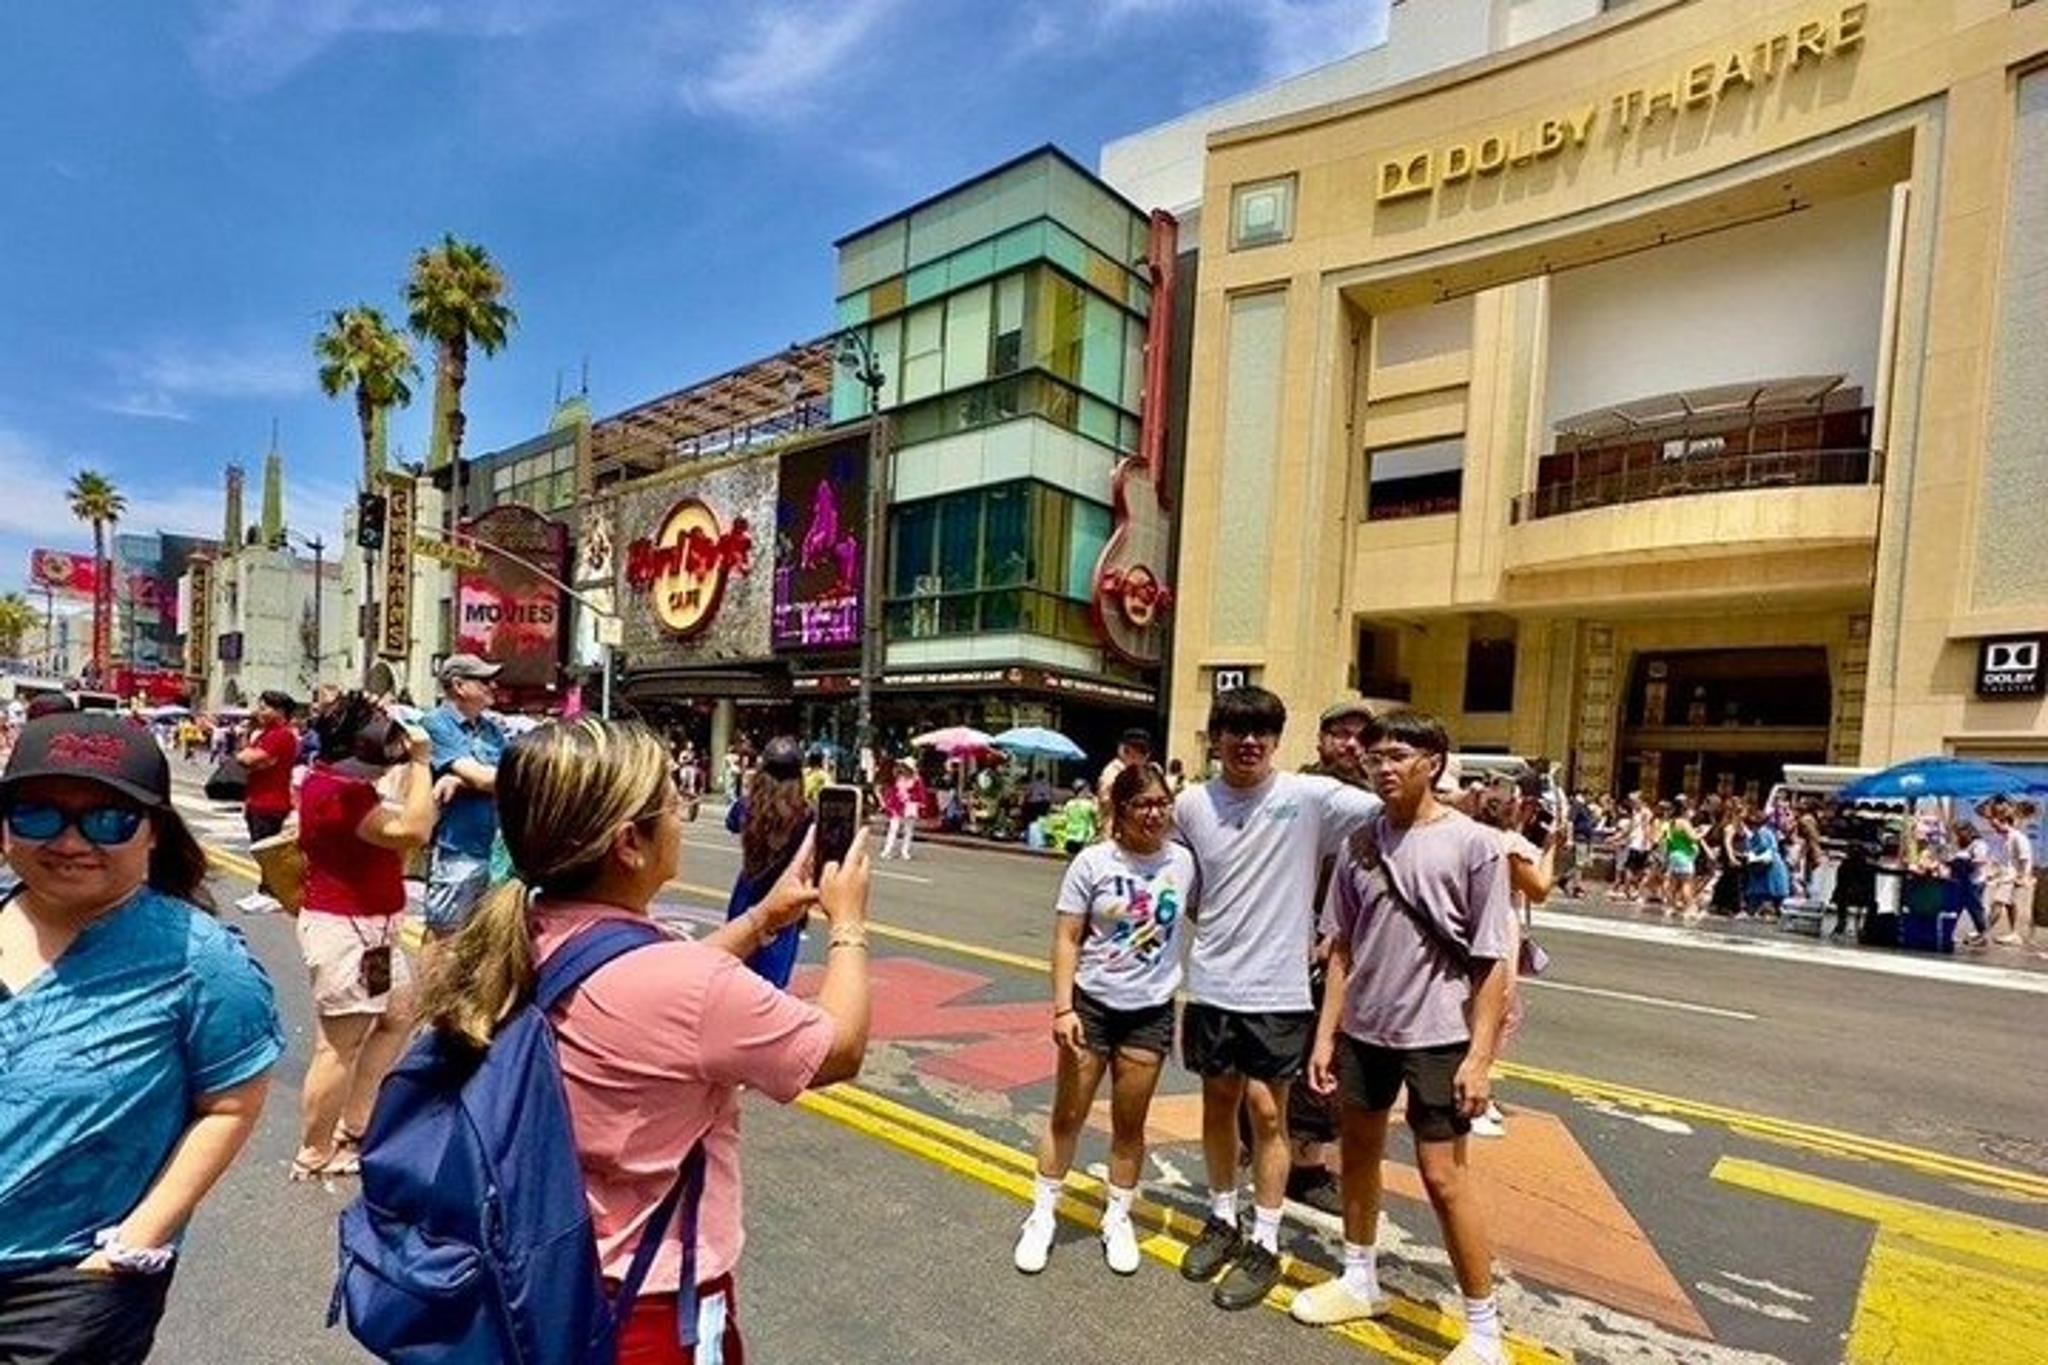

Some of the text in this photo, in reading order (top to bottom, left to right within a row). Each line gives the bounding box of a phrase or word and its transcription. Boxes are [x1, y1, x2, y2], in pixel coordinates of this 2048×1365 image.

[1442, 3, 1867, 181] DOLBY THEATRE
[466, 603, 553, 623] MOVIES
